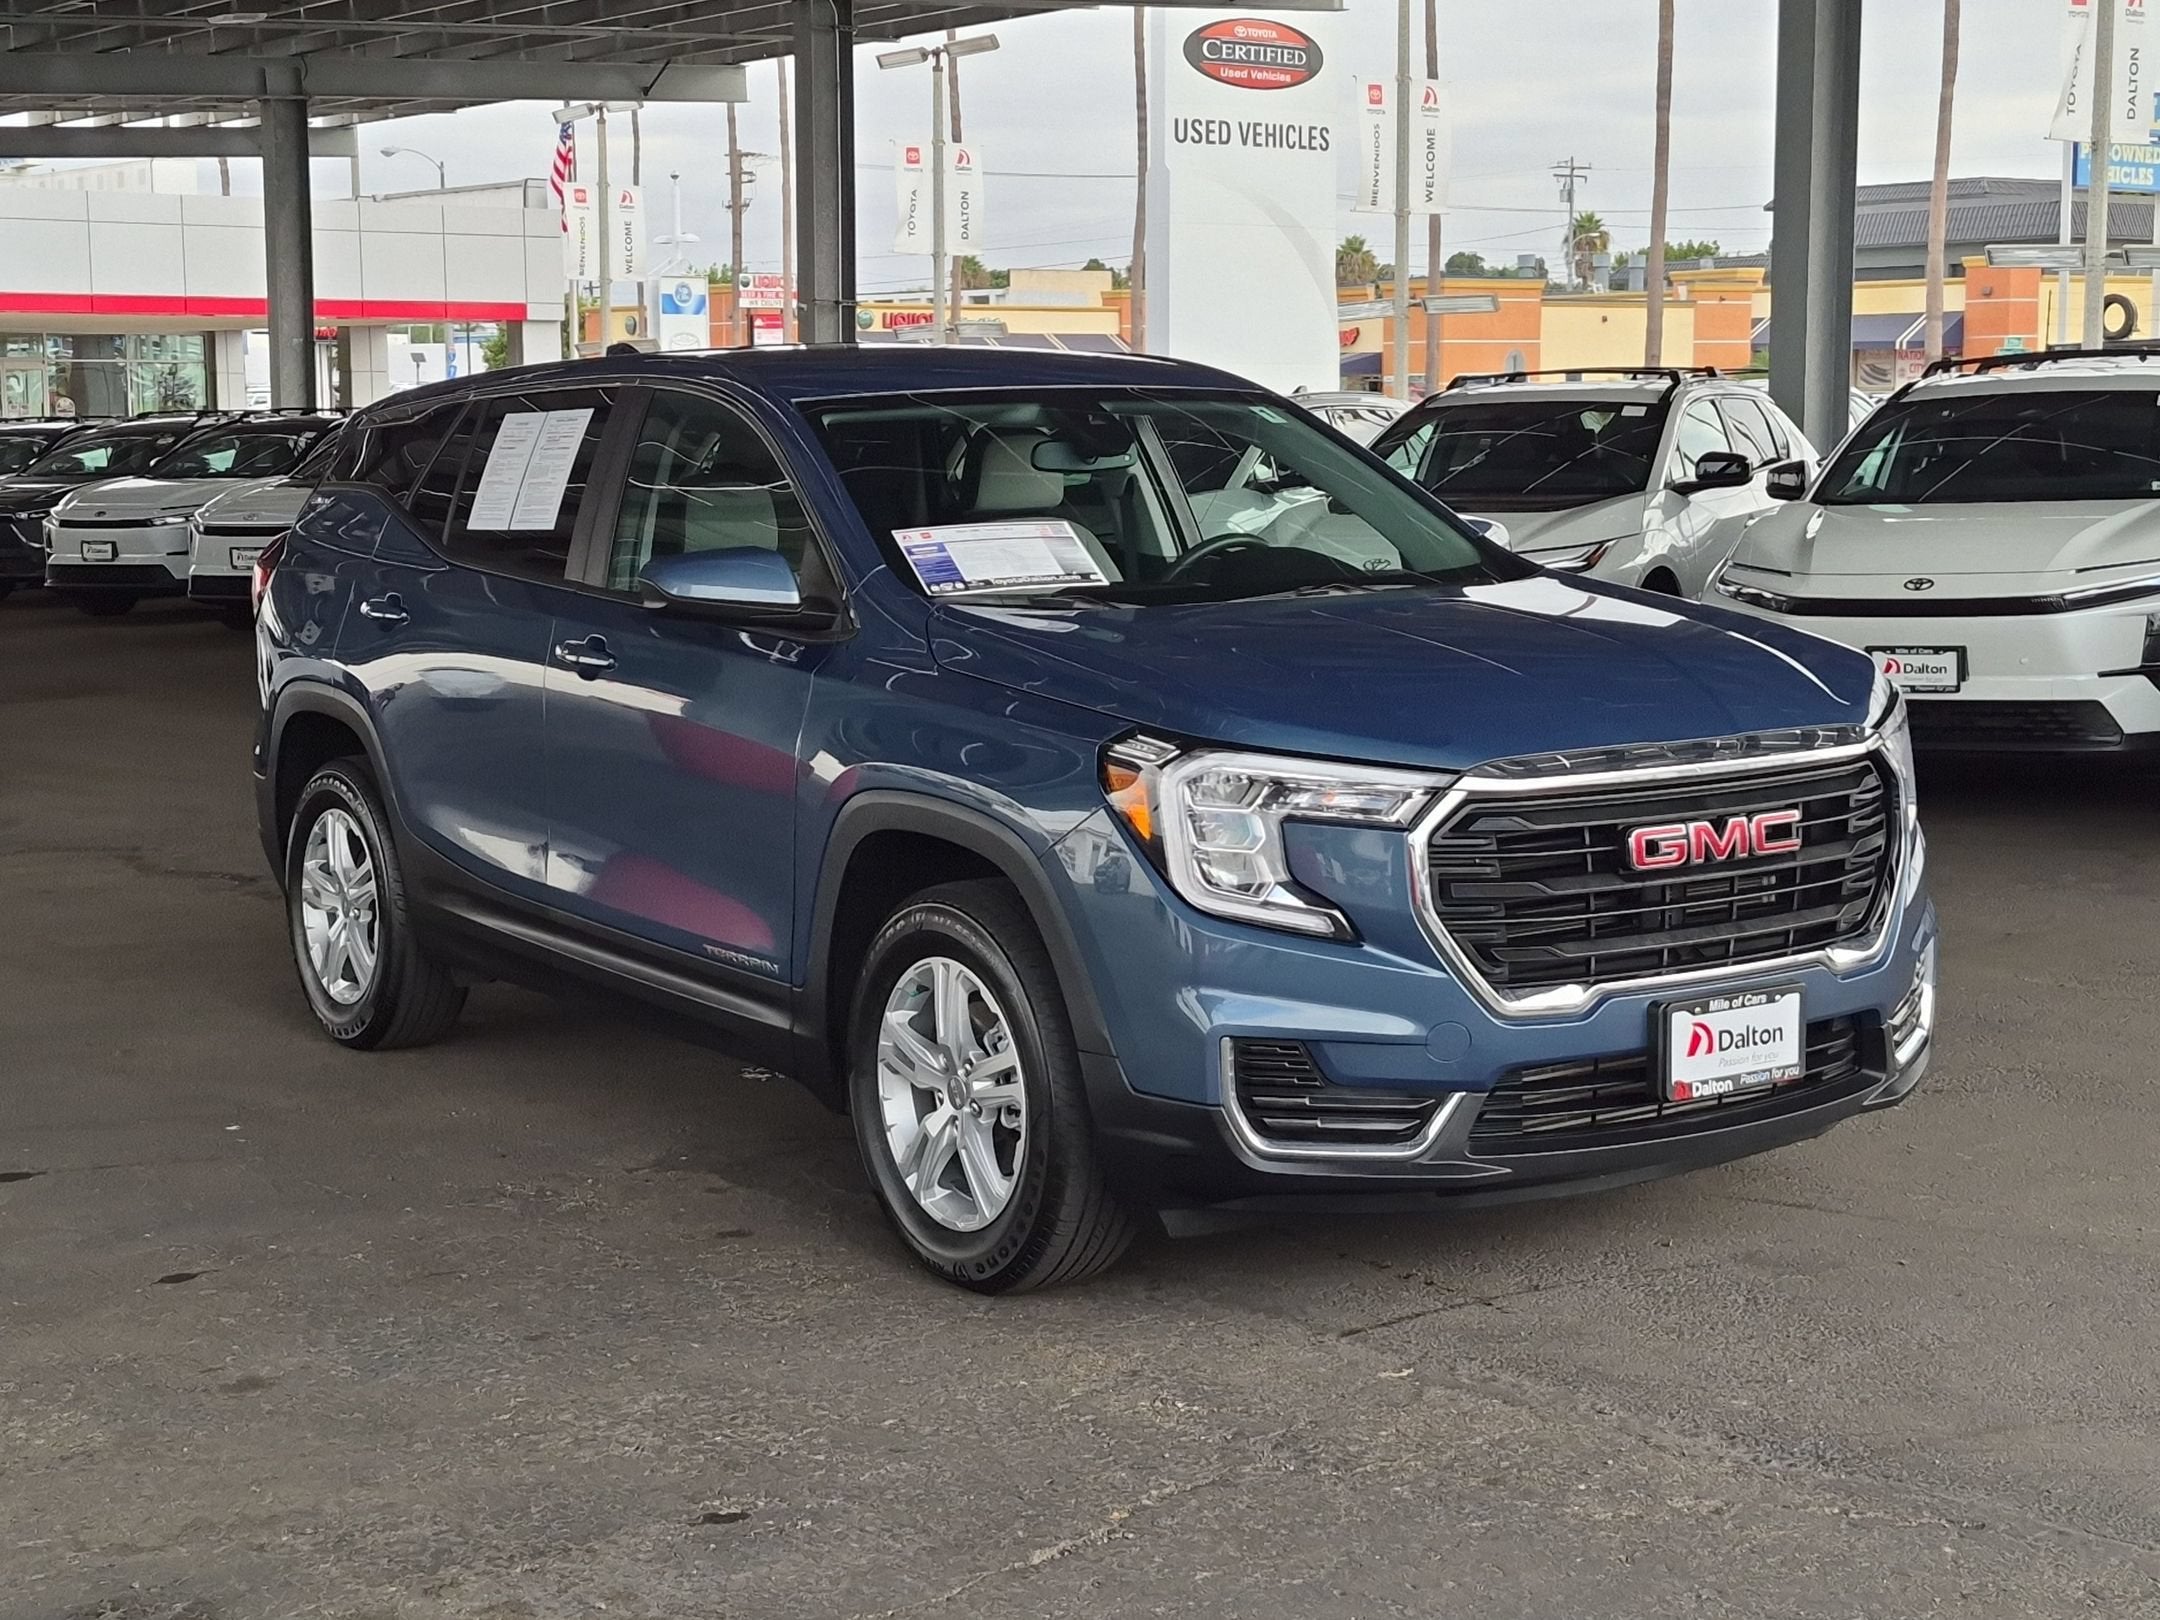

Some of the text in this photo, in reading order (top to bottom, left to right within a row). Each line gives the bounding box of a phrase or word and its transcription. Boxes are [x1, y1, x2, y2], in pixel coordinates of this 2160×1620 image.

[1247, 28, 1278, 39] TOYOTA
[1202, 39, 1307, 66] CERTIFIED
[1220, 67, 1292, 82] Used Vehicles
[2066, 44, 2082, 117] TOYOTA
[2127, 48, 2140, 120] DALTON
[1174, 117, 1330, 152] USED VEHICLES
[1370, 123, 1381, 207] BIENVENIDOS
[1425, 128, 1436, 203] WELCOME
[907, 189, 918, 238] TOYOTA
[960, 190, 970, 240] DALTON
[624, 220, 633, 275] WELCOME
[753, 275, 784, 289] LIQUO
[882, 311, 934, 329] LIQUO
[1903, 663, 1947, 674] Dalton
[1629, 809, 1801, 871] GMC
[703, 944, 779, 975] TERRAIN
[1709, 994, 1768, 1012] Mile of Cars
[1719, 1025, 1783, 1052] Dalton
[1718, 1052, 1779, 1068] Passion for you
[1692, 1066, 1800, 1098] Dalton Passion for you
